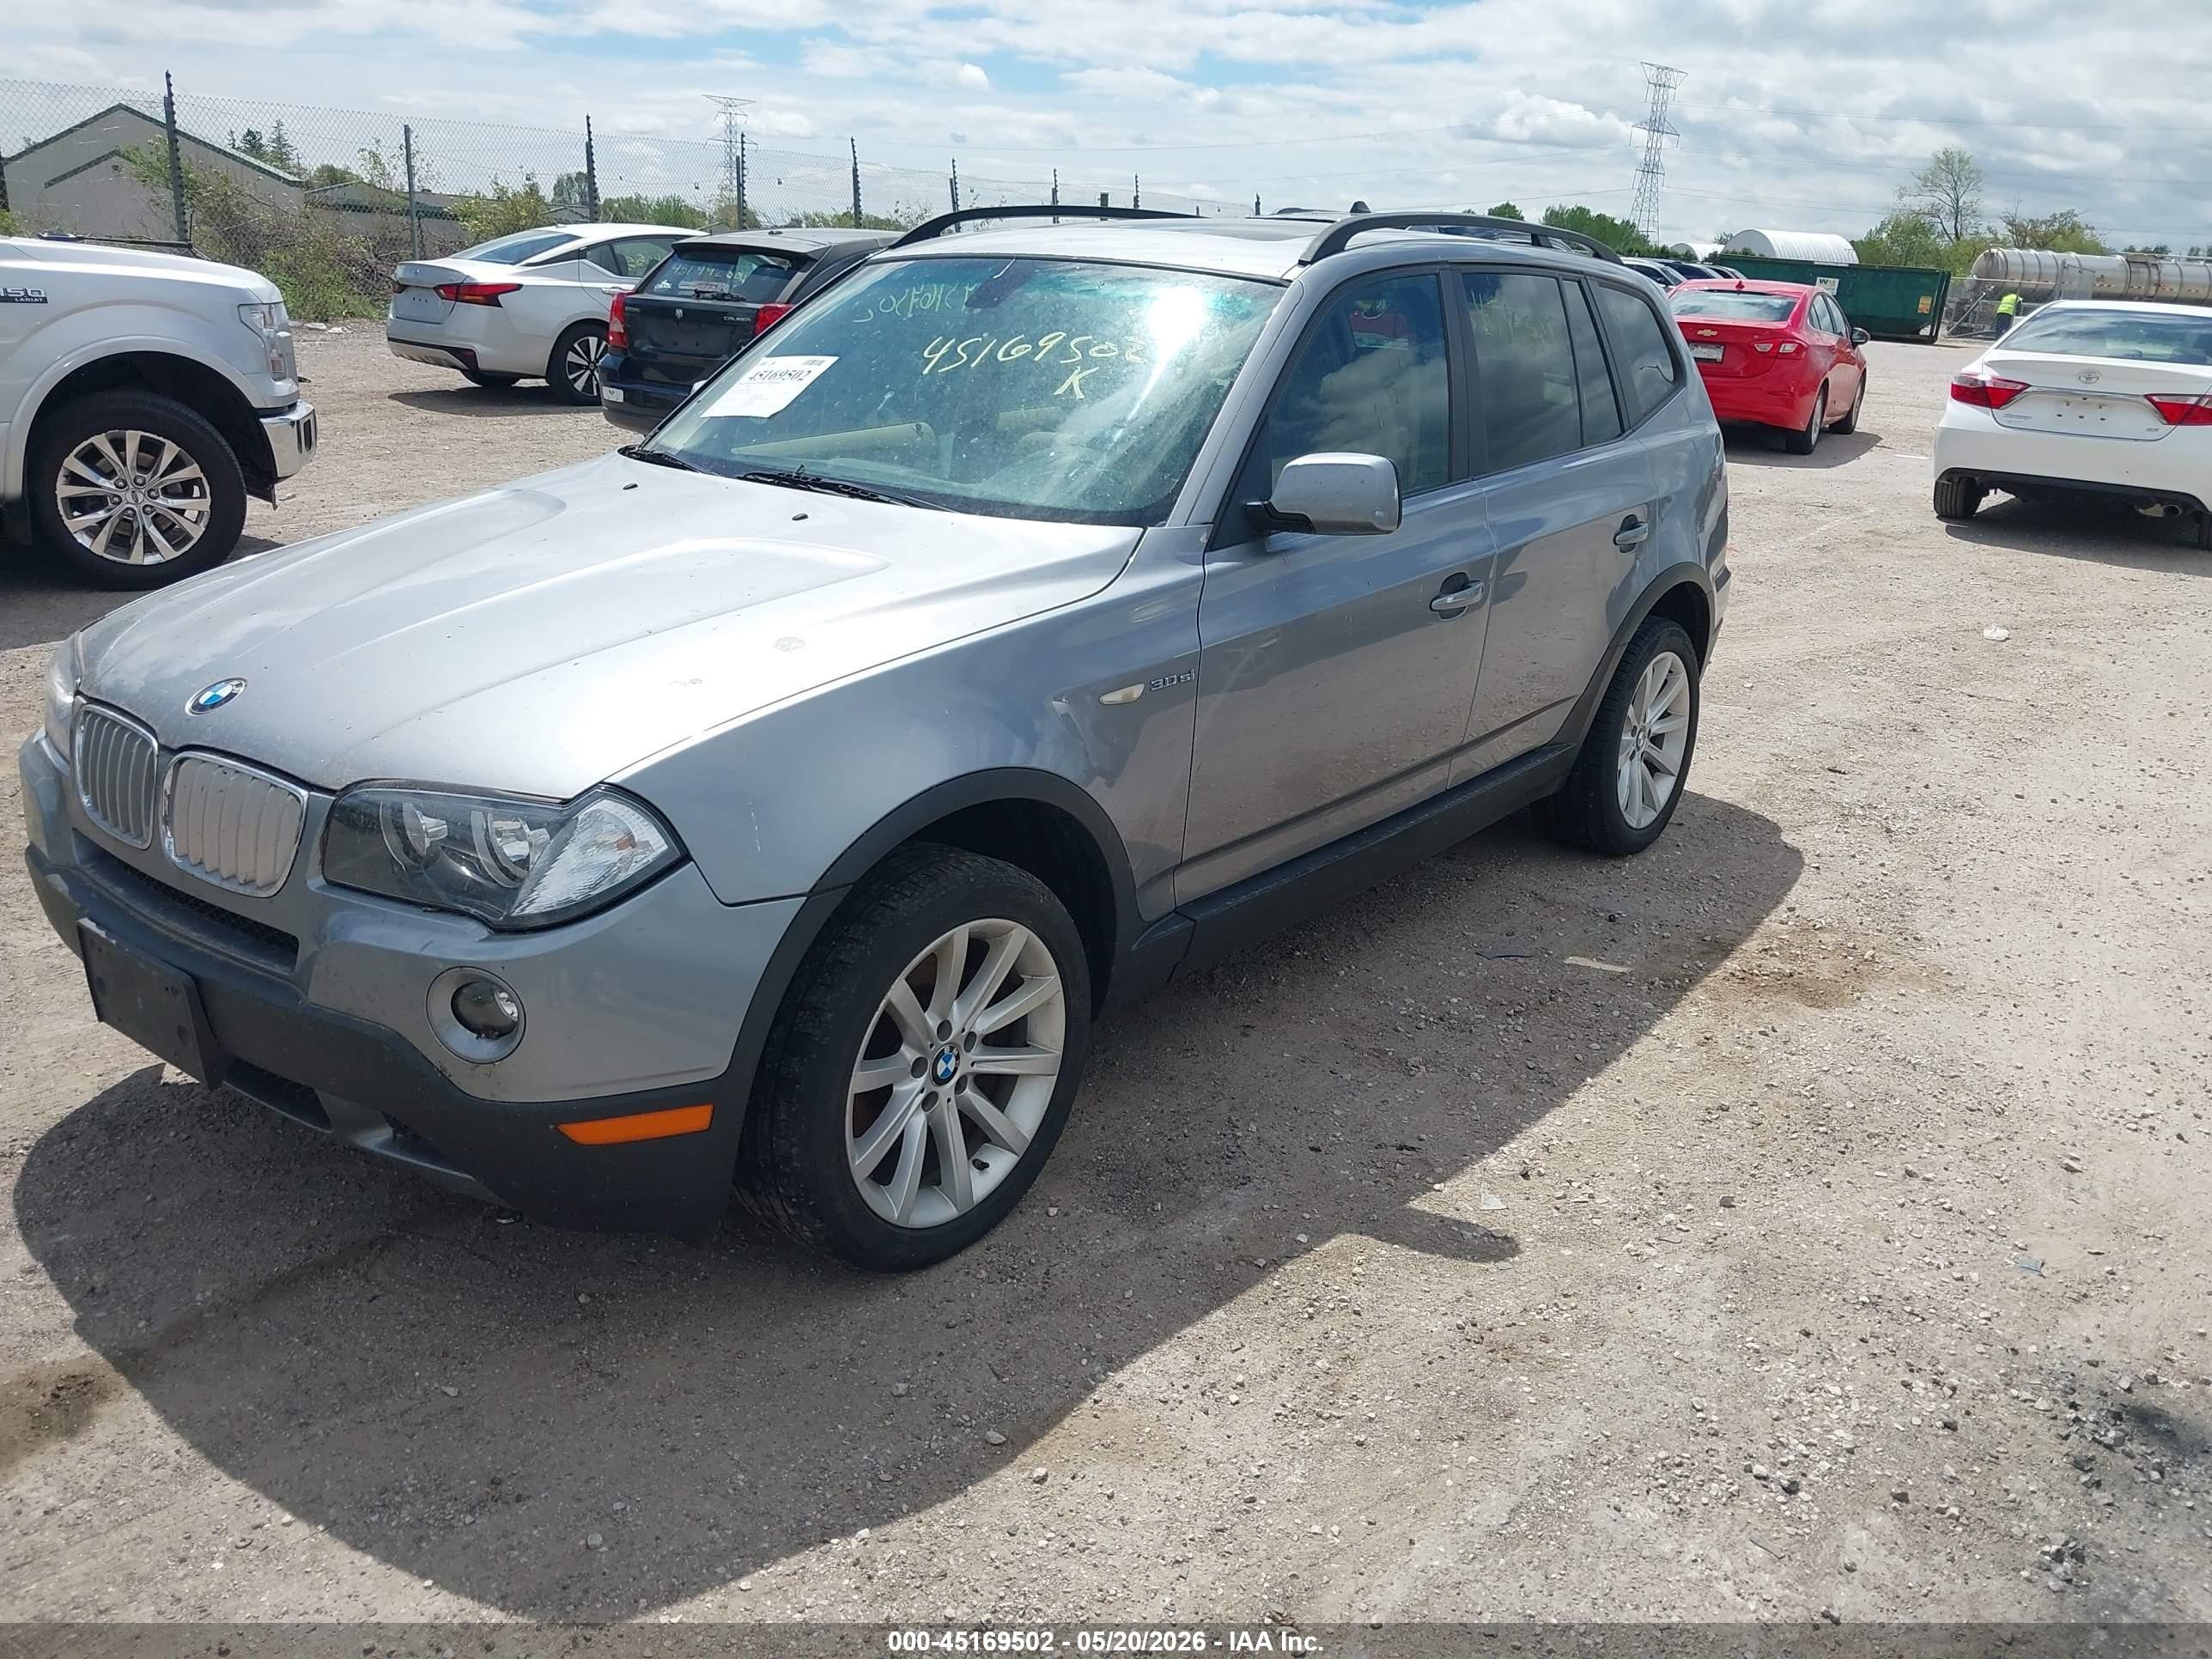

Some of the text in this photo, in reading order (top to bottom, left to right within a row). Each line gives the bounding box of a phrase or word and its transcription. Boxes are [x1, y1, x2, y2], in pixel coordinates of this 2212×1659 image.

[922, 331, 1147, 375] 45169502
[749, 369, 812, 381] 45169502
[1053, 366, 1099, 399] K
